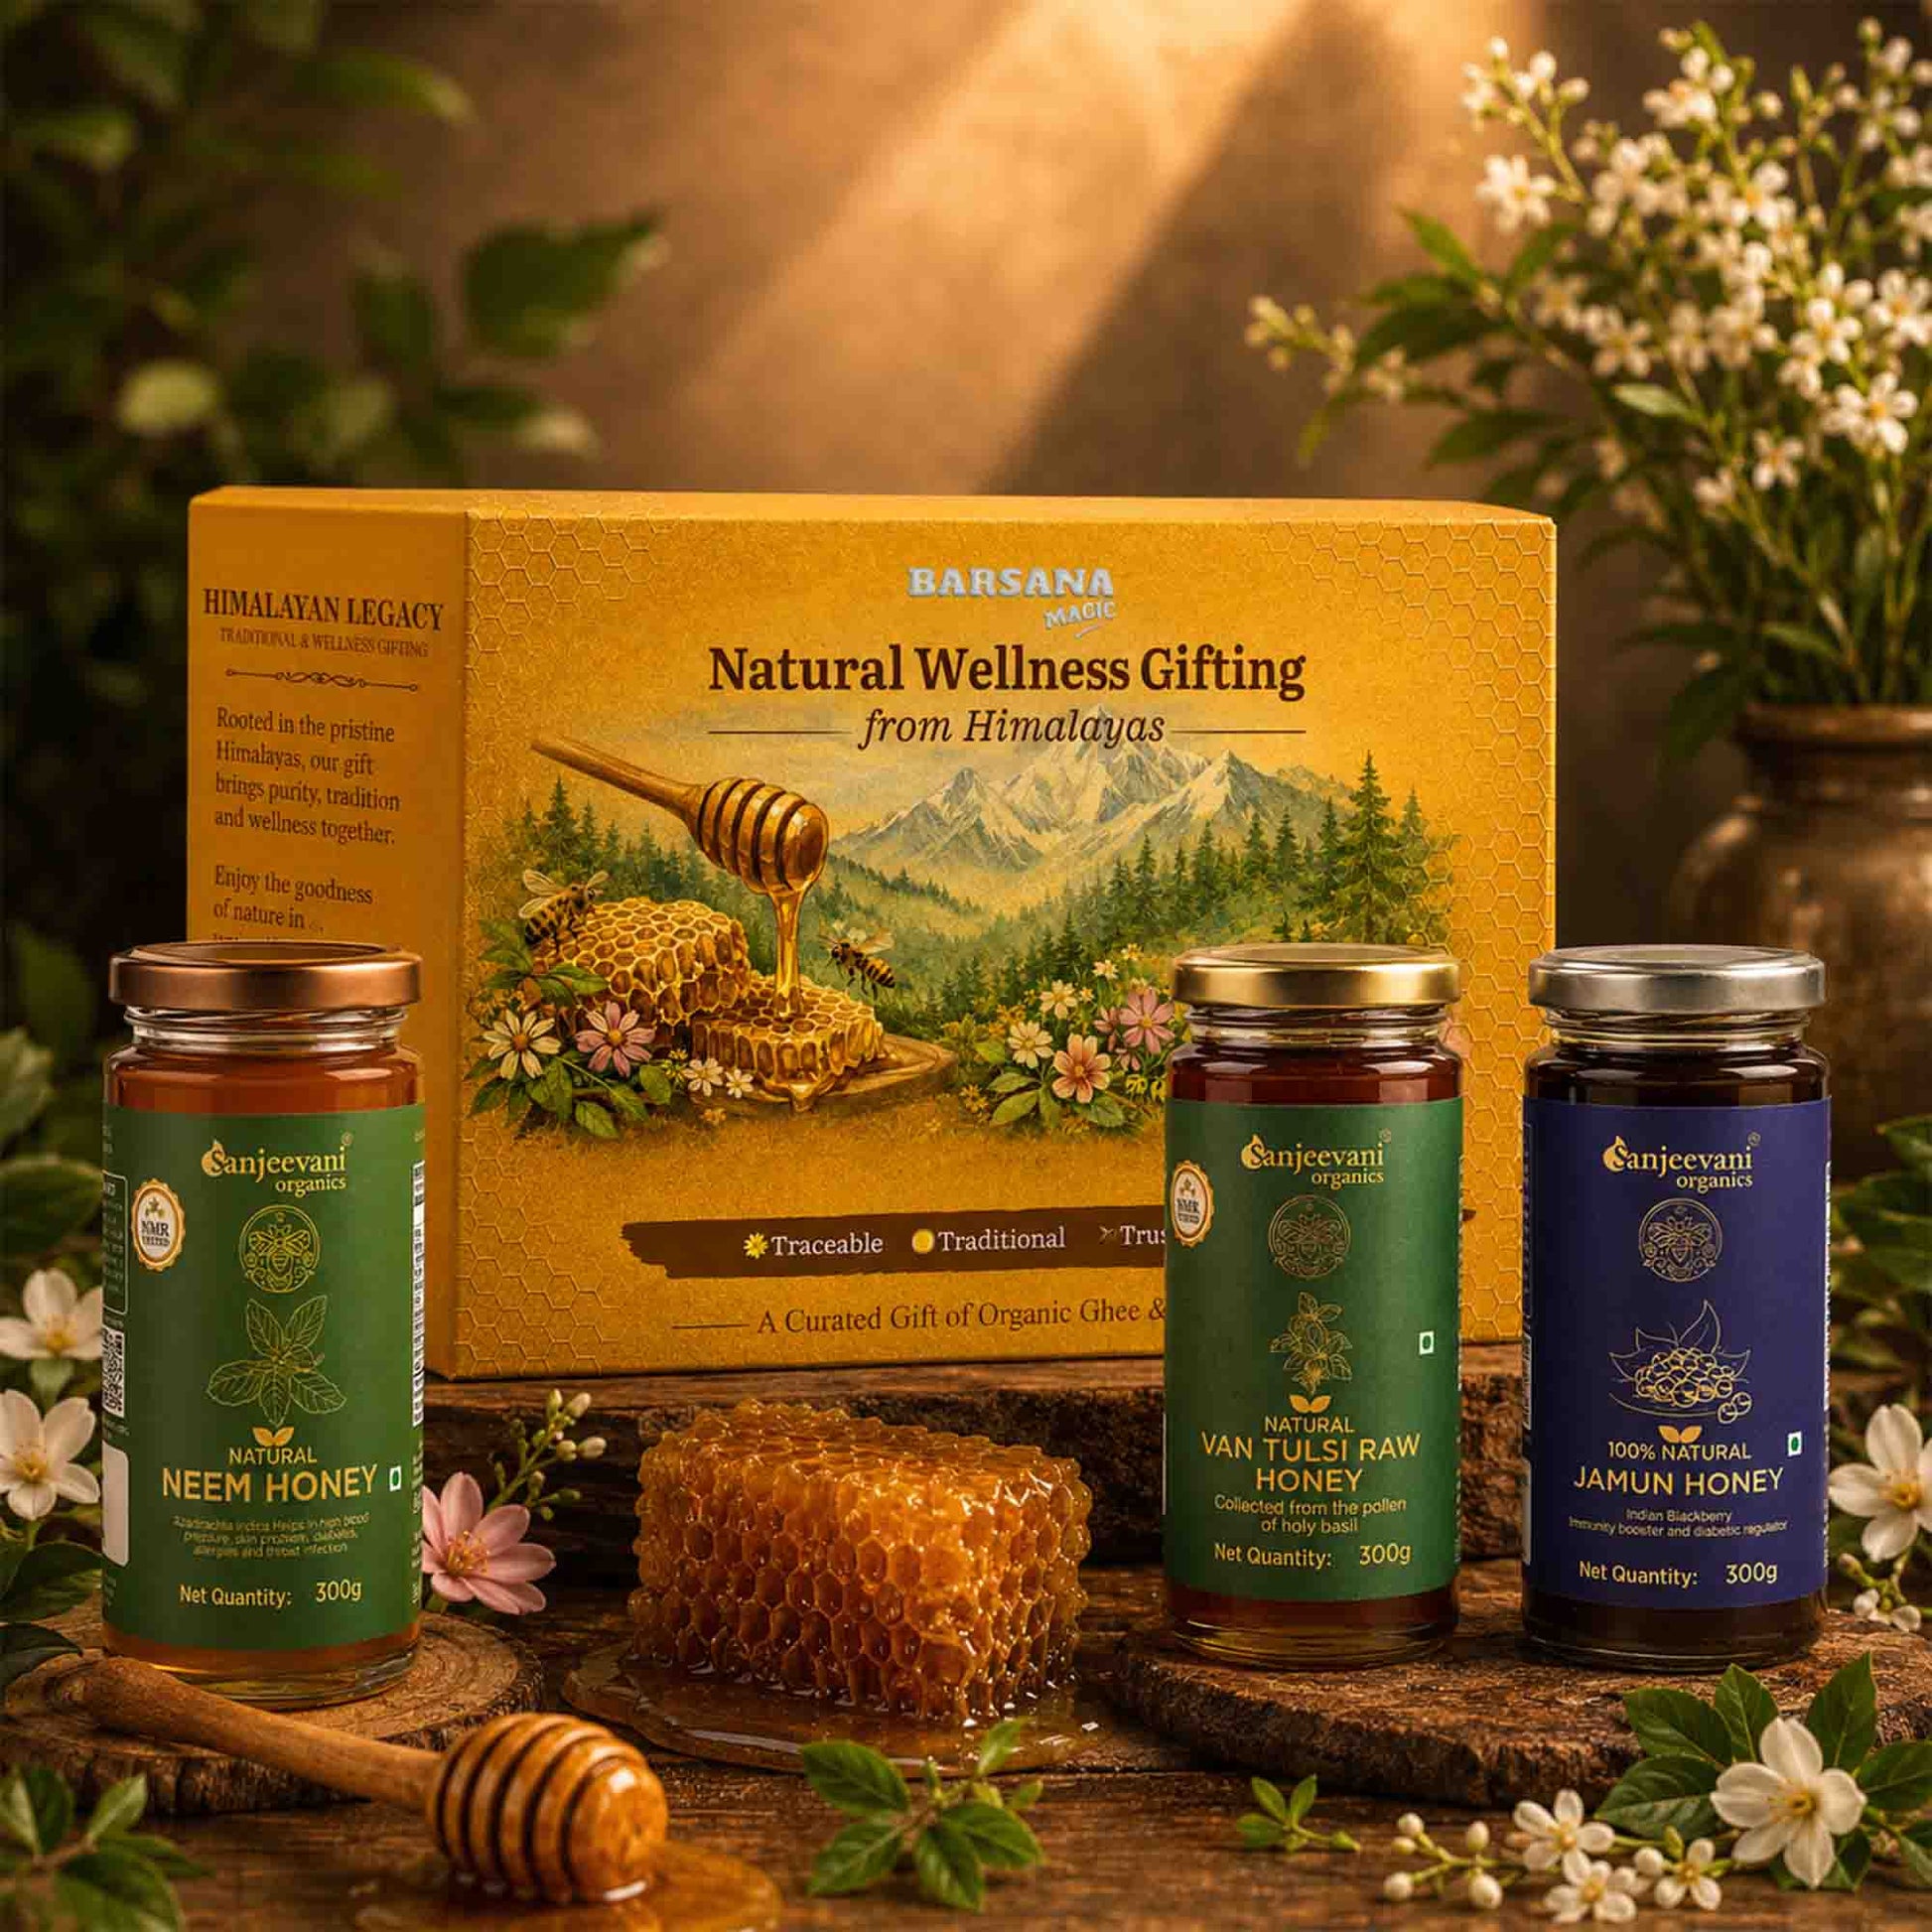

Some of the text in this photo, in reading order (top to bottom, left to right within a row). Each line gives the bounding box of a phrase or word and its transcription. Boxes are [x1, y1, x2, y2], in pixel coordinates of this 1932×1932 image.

[908, 567, 1114, 598] BARSANA
[203, 588, 444, 630] HIMALAYAN LEGACY
[1045, 601, 1117, 629] MAGIC
[219, 627, 429, 657] TRADITIONAL & WELLNESS GIFTING
[709, 643, 1307, 702] Natural Wellness Gifting
[216, 707, 394, 746] Rooted in the pristine
[858, 708, 1166, 749] from Himalayas
[216, 741, 373, 778] Himalayas, our gift
[215, 772, 401, 811] brings purity, tradition
[215, 808, 395, 845] and wellness together.
[214, 864, 373, 903] Enjoy the goodness
[213, 897, 231, 918] of
[233, 904, 285, 926] nature
[289, 907, 305, 928] in
[202, 1140, 346, 1182] Sanjeevani
[1241, 1134, 1384, 1174] Sanjeevani
[1602, 1135, 1752, 1177] Sanjeevani
[276, 1174, 346, 1197] organics
[1311, 1169, 1384, 1190] organics
[1677, 1172, 1753, 1193] organics
[771, 1232, 884, 1257] Traceable
[937, 1227, 1065, 1253] Traditional
[758, 1297, 1166, 1333] A Curated Gift of Organic Ghee &
[1264, 1416, 1355, 1434] NATURAL
[228, 1446, 317, 1464] NATURAL
[1201, 1432, 1421, 1462] VAN TULSI RAW
[1607, 1441, 1752, 1461] 100% NATURAL
[162, 1467, 251, 1502] NEEM
[265, 1464, 377, 1502] HONEY
[1256, 1467, 1362, 1492] HONEY
[1574, 1466, 1784, 1496] JAMUN HONEY
[1214, 1494, 1407, 1517] Collected from the pollen
[1626, 1508, 1732, 1523] Indian Blackberry
[1261, 1518, 1358, 1537] of holy basil
[1569, 1515, 1615, 1535] Immunity
[1618, 1523, 1663, 1536] booster
[1667, 1524, 1690, 1537] and
[1693, 1523, 1740, 1537] diabetic
[1214, 1543, 1412, 1570] Net Quantity: 300g
[1580, 1561, 1777, 1587] Net Quantity: 300g
[180, 1579, 361, 1608] Net Quantity: 300g
